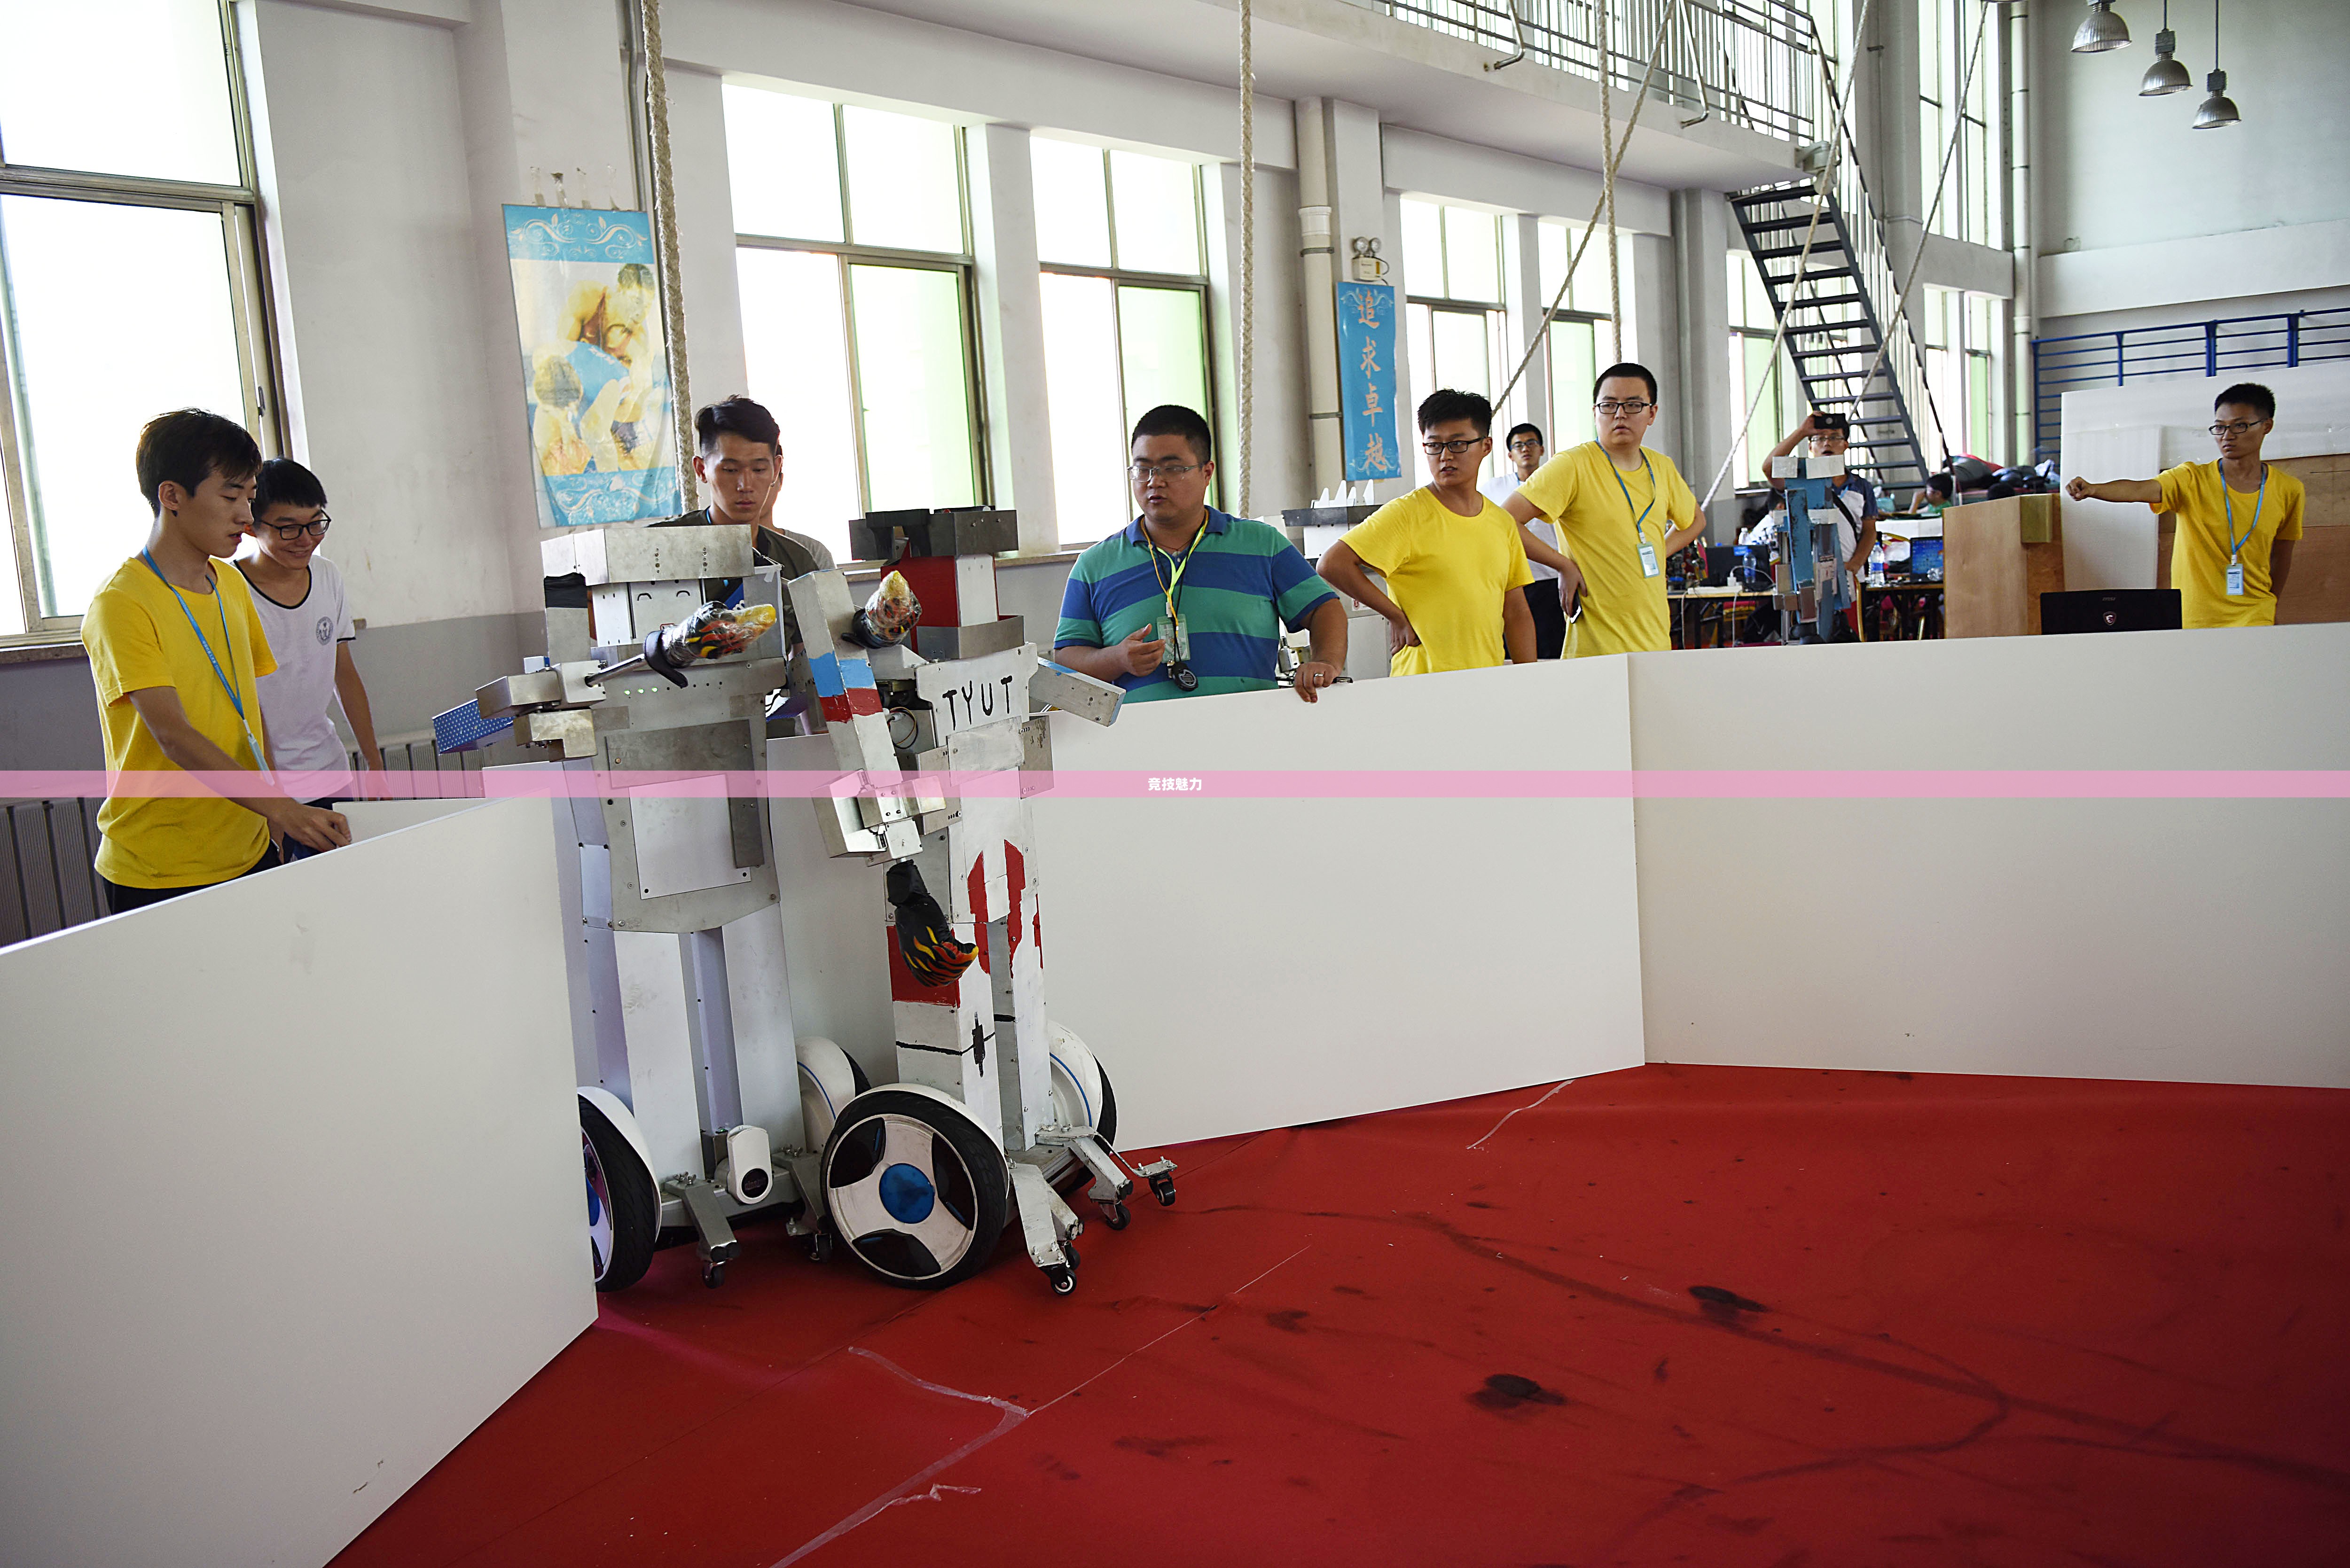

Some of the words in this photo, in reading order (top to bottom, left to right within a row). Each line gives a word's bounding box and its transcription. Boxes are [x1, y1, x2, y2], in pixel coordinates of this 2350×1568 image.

[1358, 290, 1386, 470] 追求卓越
[942, 675, 1012, 731] TYUT
